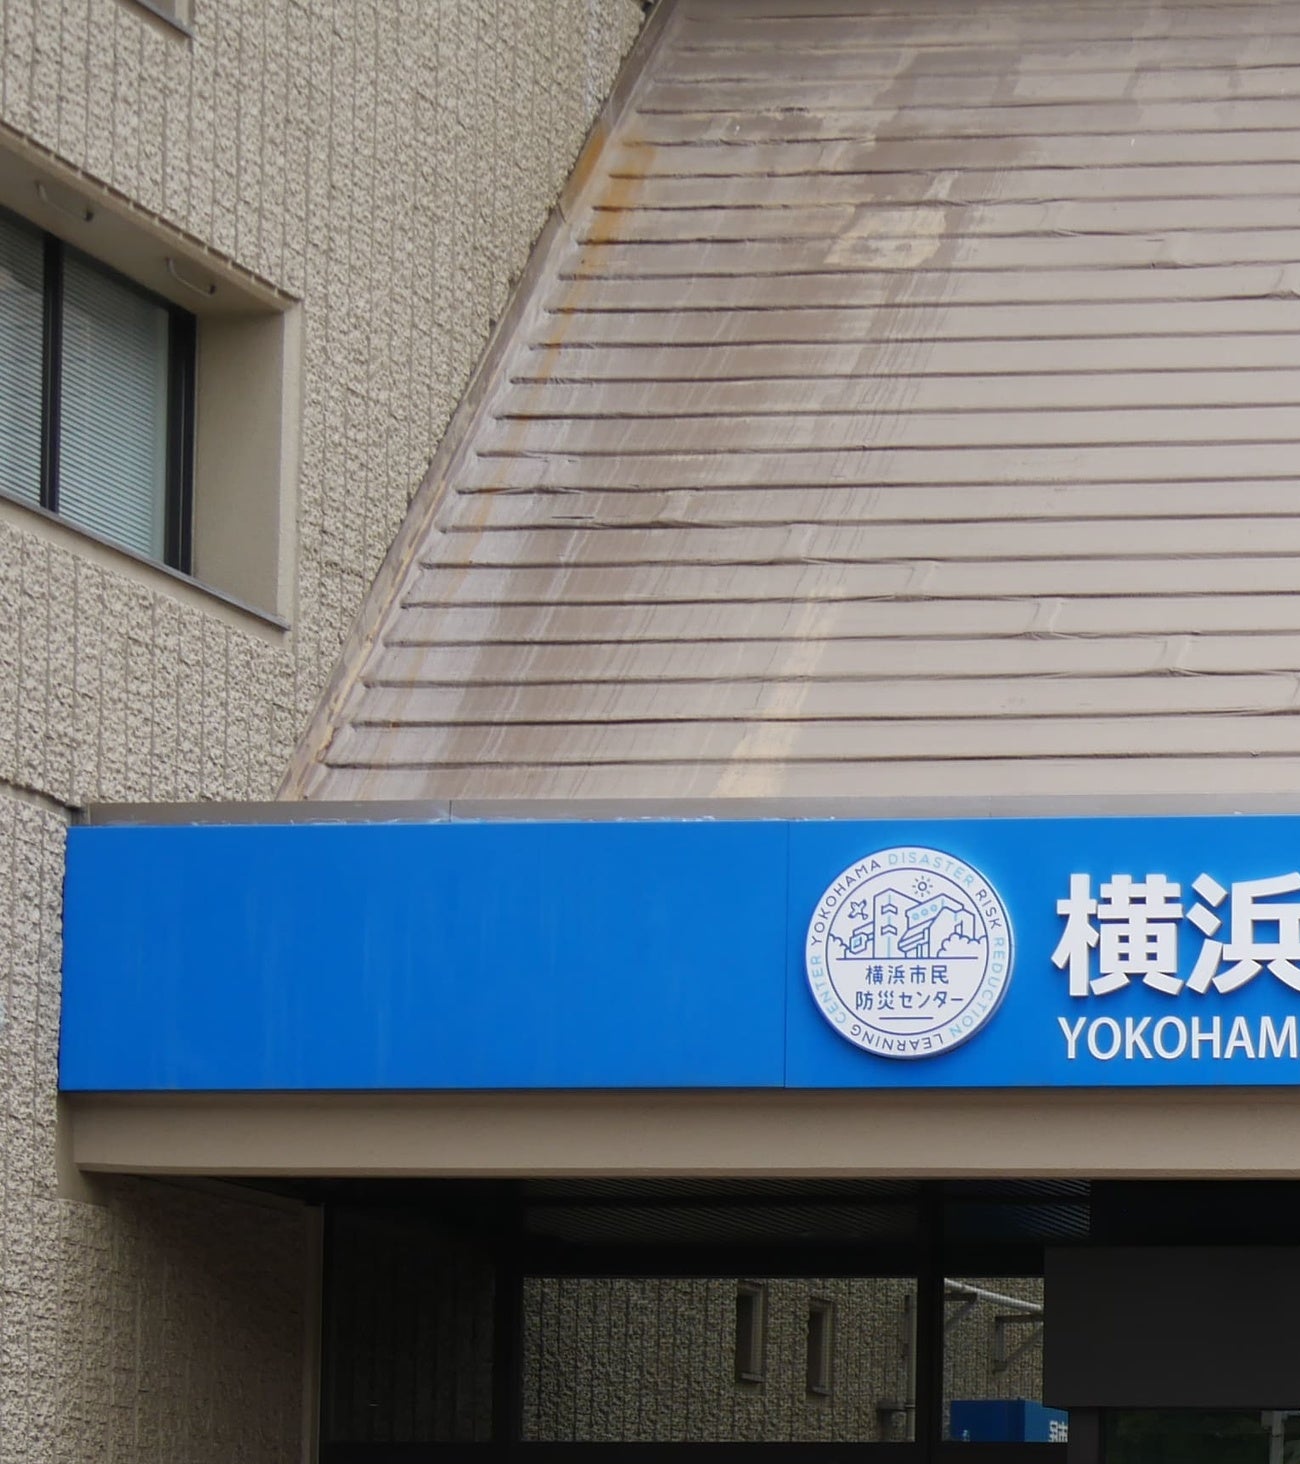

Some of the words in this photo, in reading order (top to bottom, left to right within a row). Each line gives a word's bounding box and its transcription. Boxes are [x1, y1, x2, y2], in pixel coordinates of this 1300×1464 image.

[888, 852, 974, 887] DISASTER
[811, 858, 881, 946] YOKOHAMA
[975, 889, 1002, 930] RISK
[810, 954, 847, 1025] CENTER
[865, 965, 949, 985] 横浜市民
[948, 938, 1006, 1037] REDUCTION
[855, 991, 964, 1011] 防災センター
[850, 1023, 944, 1052] LEARNING
